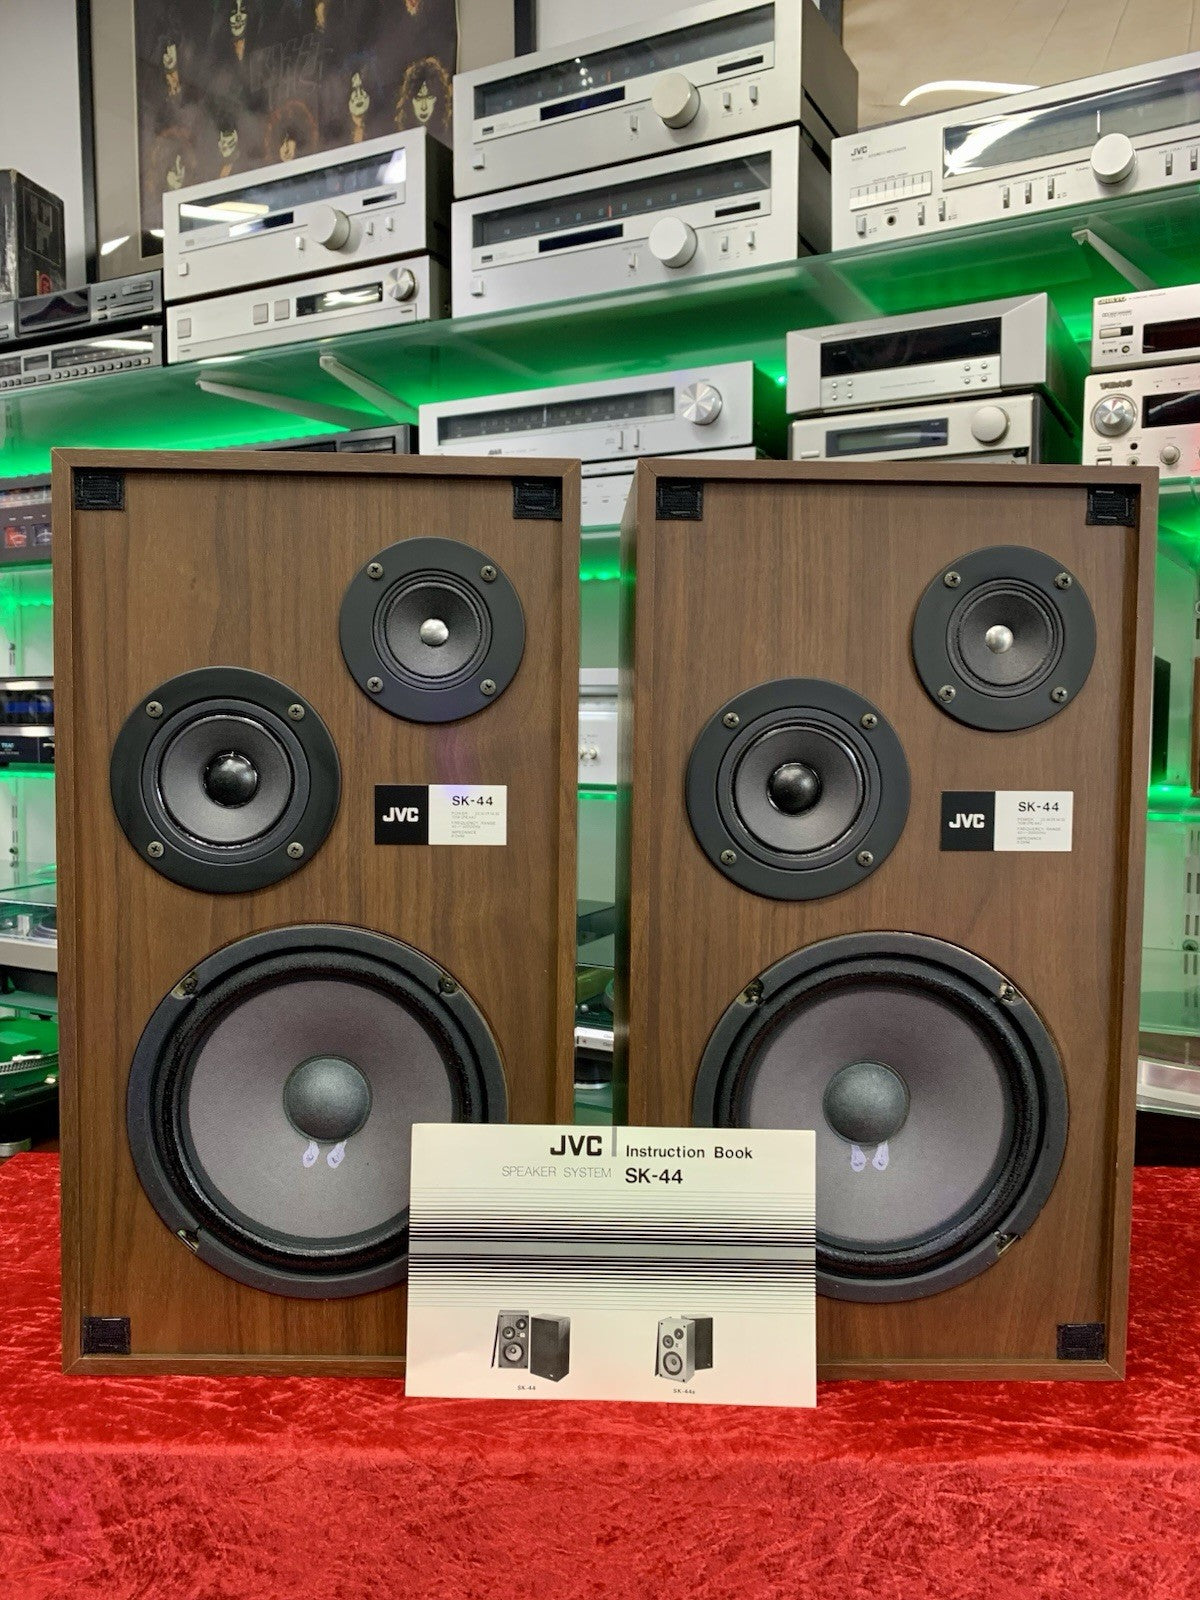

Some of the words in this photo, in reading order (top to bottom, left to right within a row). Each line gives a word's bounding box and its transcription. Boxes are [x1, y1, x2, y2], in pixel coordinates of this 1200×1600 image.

[850, 145, 868, 156] JVC
[452, 795, 493, 806] SK-44
[1018, 801, 1060, 812] SK-44
[382, 807, 419, 822] JVC
[948, 813, 985, 829] JVC
[550, 1135, 603, 1157] JVC
[625, 1144, 705, 1159] Instruction
[713, 1145, 753, 1159] Book
[501, 1165, 557, 1178] SPEAKER
[563, 1166, 612, 1179] SYSTEM
[625, 1167, 683, 1184] SK-44
